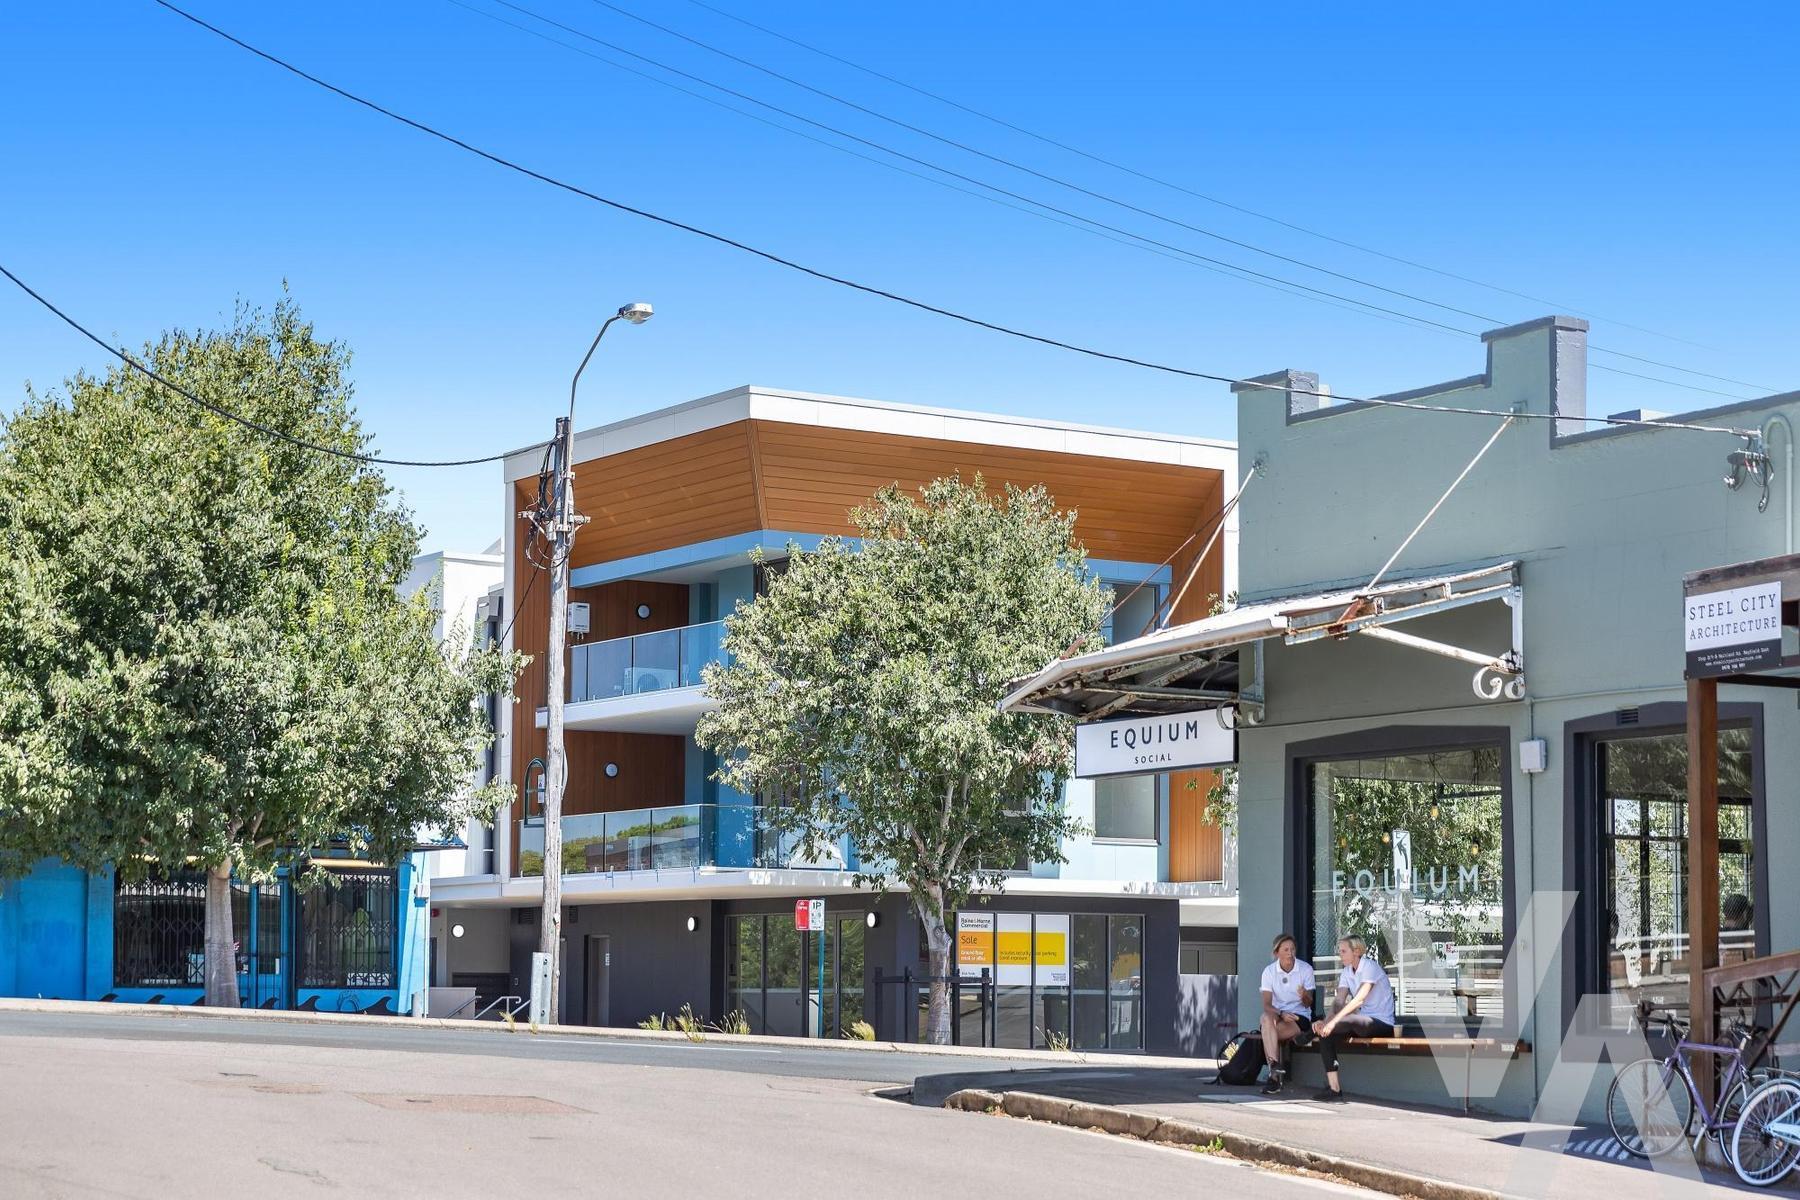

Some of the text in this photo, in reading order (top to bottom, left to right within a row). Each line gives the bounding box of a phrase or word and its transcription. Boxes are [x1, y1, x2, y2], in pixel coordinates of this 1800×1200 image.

[1689, 593, 1776, 621] STEEL CITY
[1689, 616, 1777, 640] ARCHITECTURE
[1110, 720, 1198, 750] EQUIUM
[1135, 753, 1172, 765] SOCIAL
[1332, 863, 1479, 900] EQUIUM
[960, 935, 978, 944] Sale
